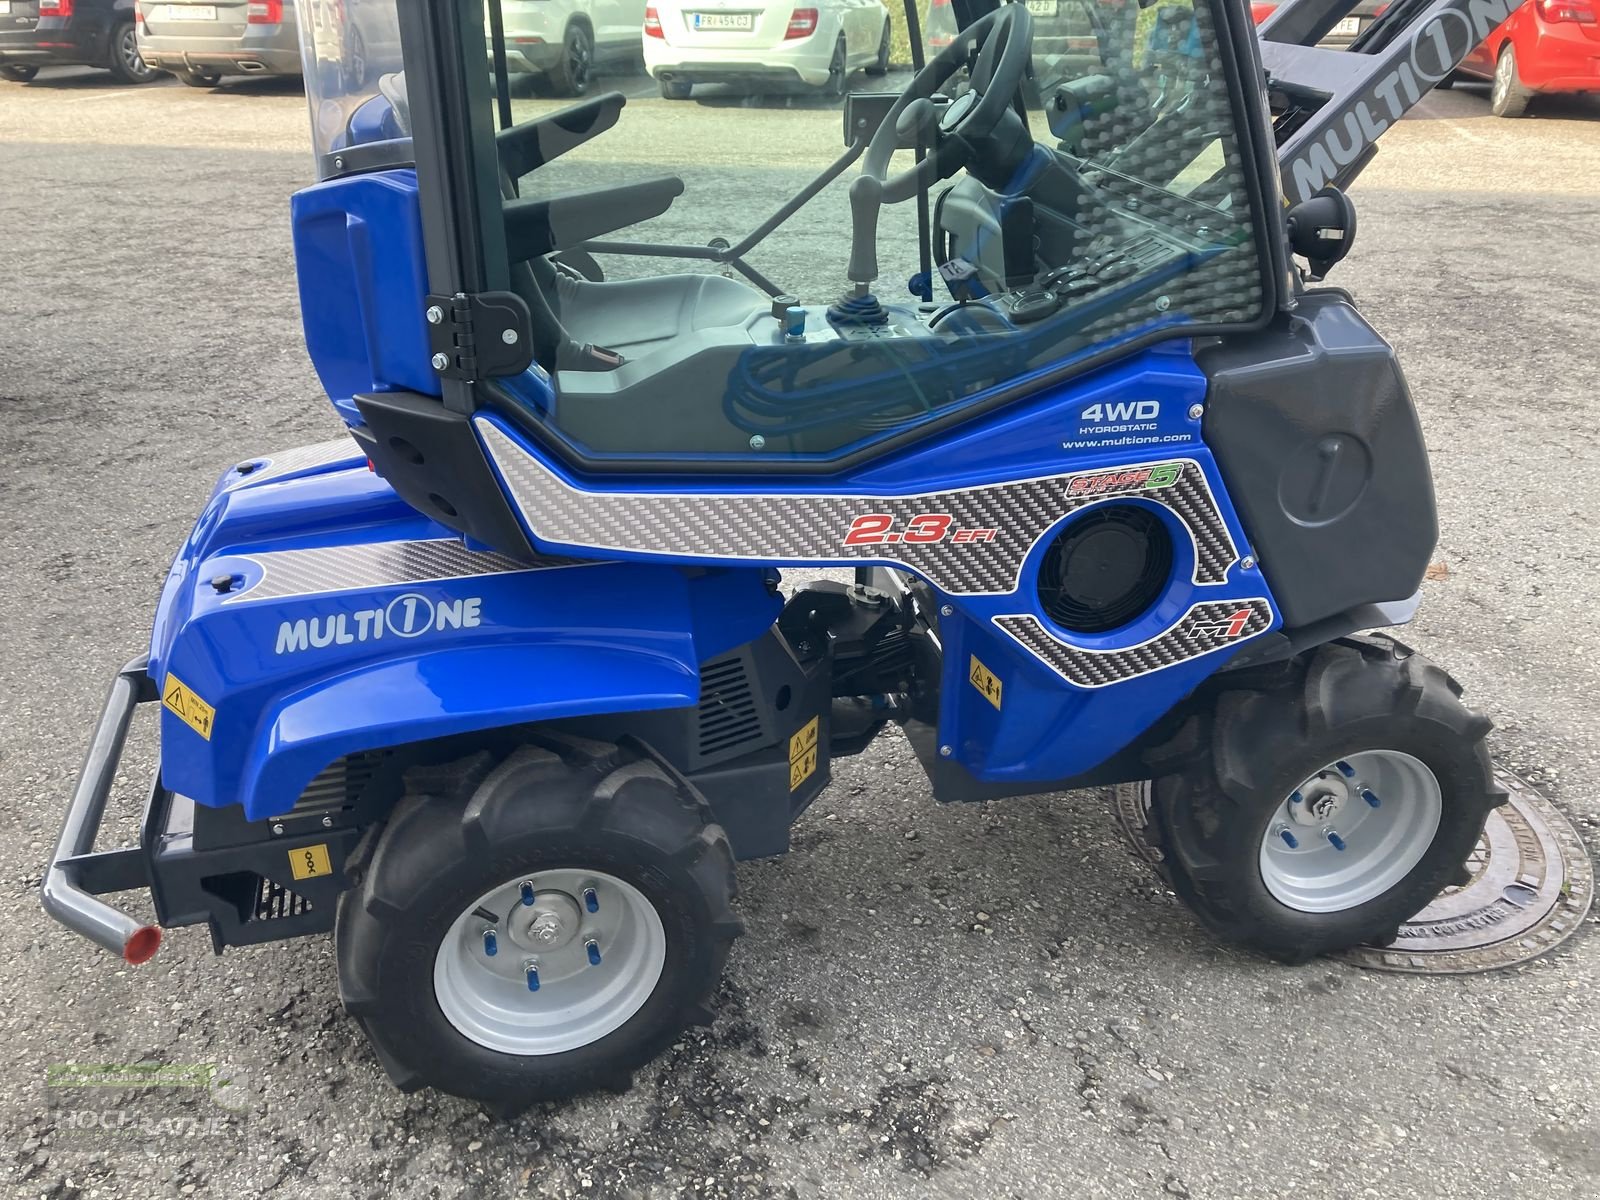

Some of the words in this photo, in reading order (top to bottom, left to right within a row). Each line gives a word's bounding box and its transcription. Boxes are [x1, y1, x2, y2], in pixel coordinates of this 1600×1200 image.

[701, 16, 712, 26] FR
[1081, 401, 1160, 423] 4WD
[1080, 423, 1157, 434] HYDROSTATIC
[1063, 433, 1191, 448] www.multione.com
[1071, 469, 1152, 490] STAGE
[1146, 463, 1183, 488] 5
[843, 513, 952, 546] 2.3
[950, 528, 998, 544] EFI
[1186, 608, 1255, 639] M1
